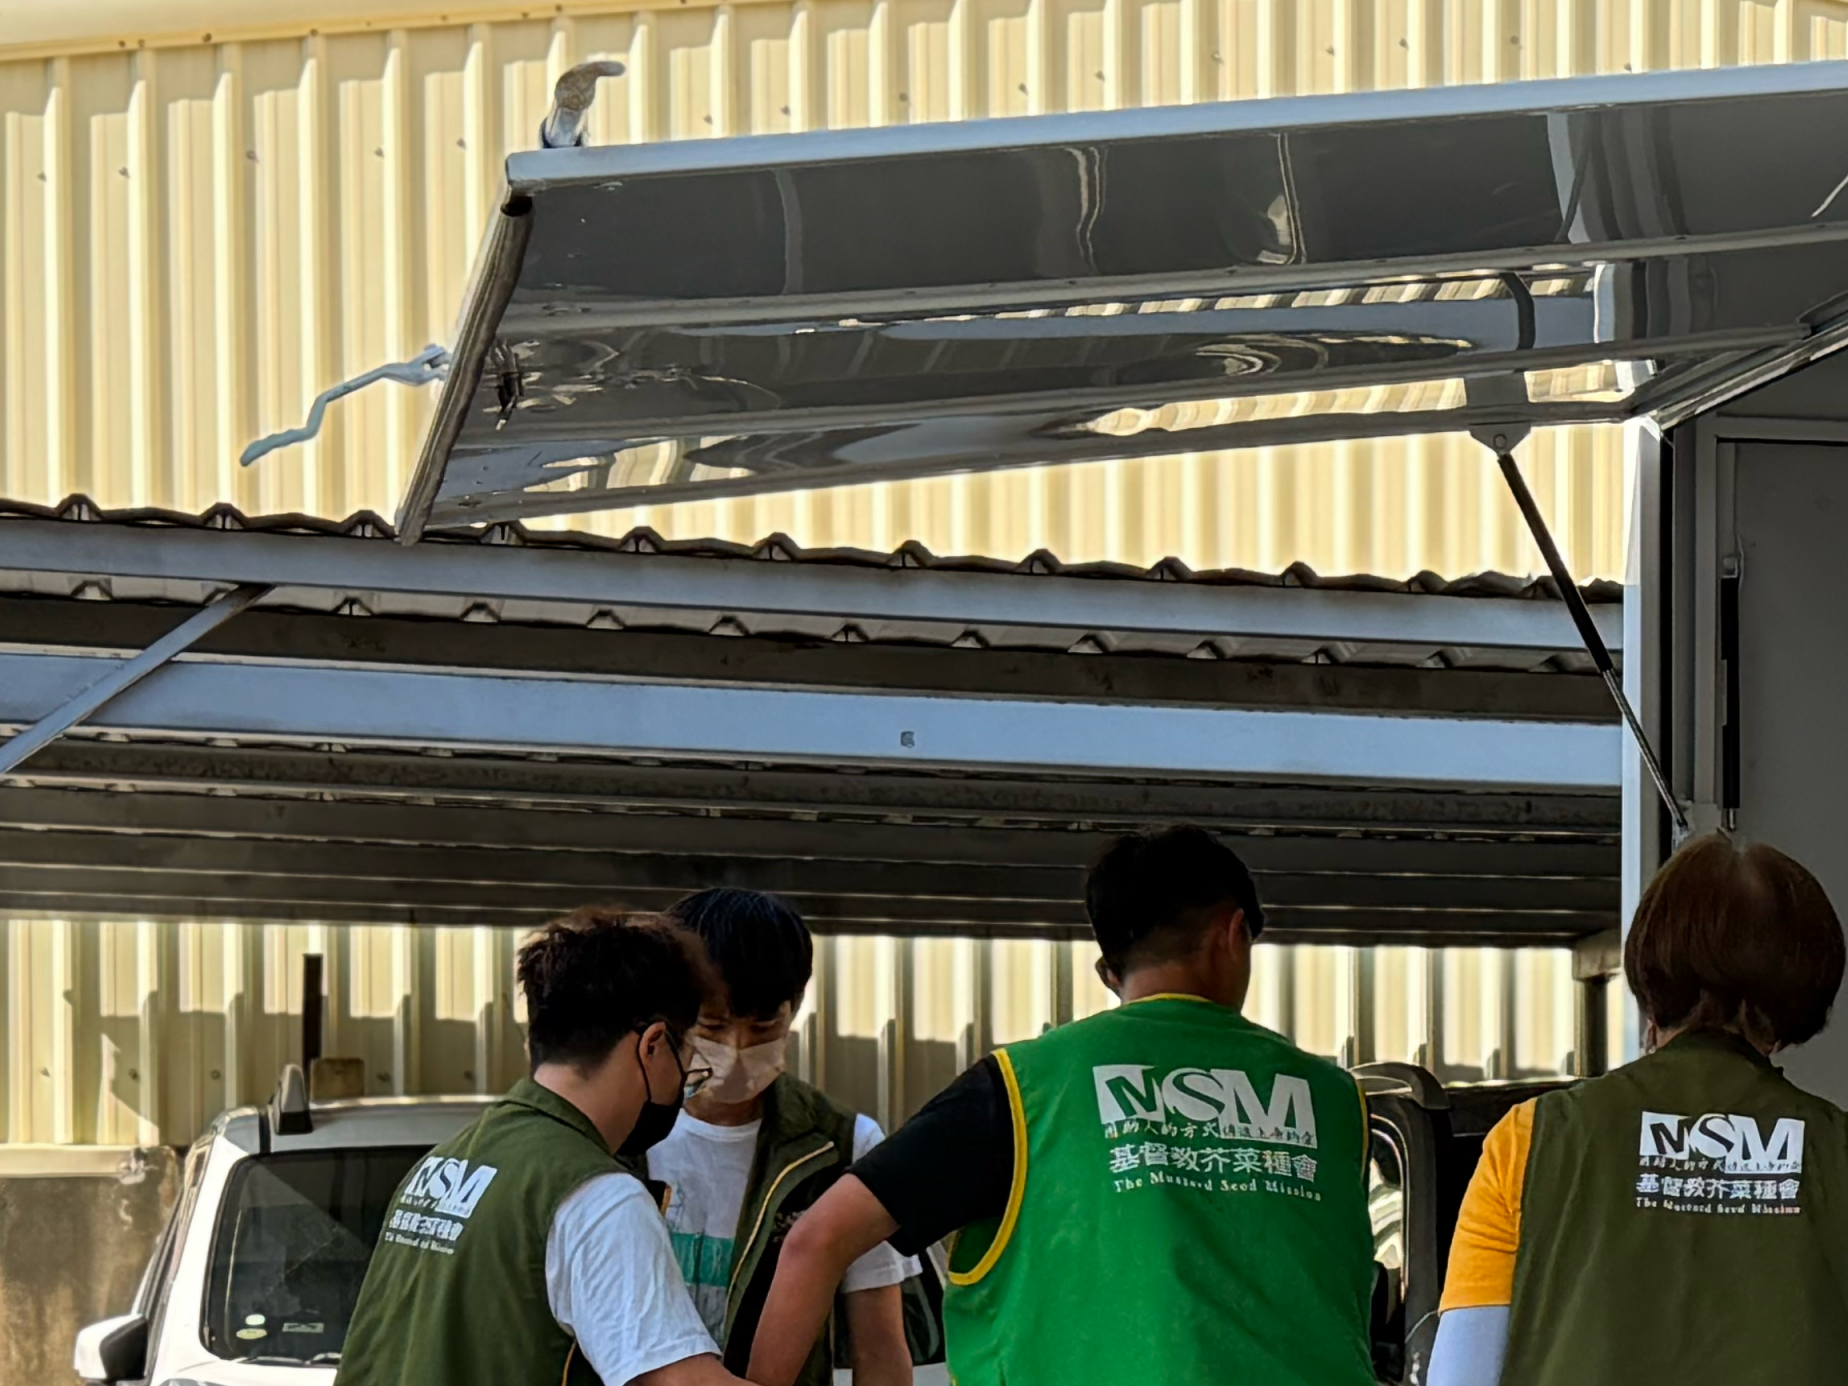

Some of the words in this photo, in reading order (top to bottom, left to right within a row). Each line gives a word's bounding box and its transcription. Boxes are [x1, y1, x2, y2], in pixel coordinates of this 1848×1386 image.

[1109, 1141, 1318, 1183] 基督教芥菜種會
[1114, 1177, 1143, 1193] The
